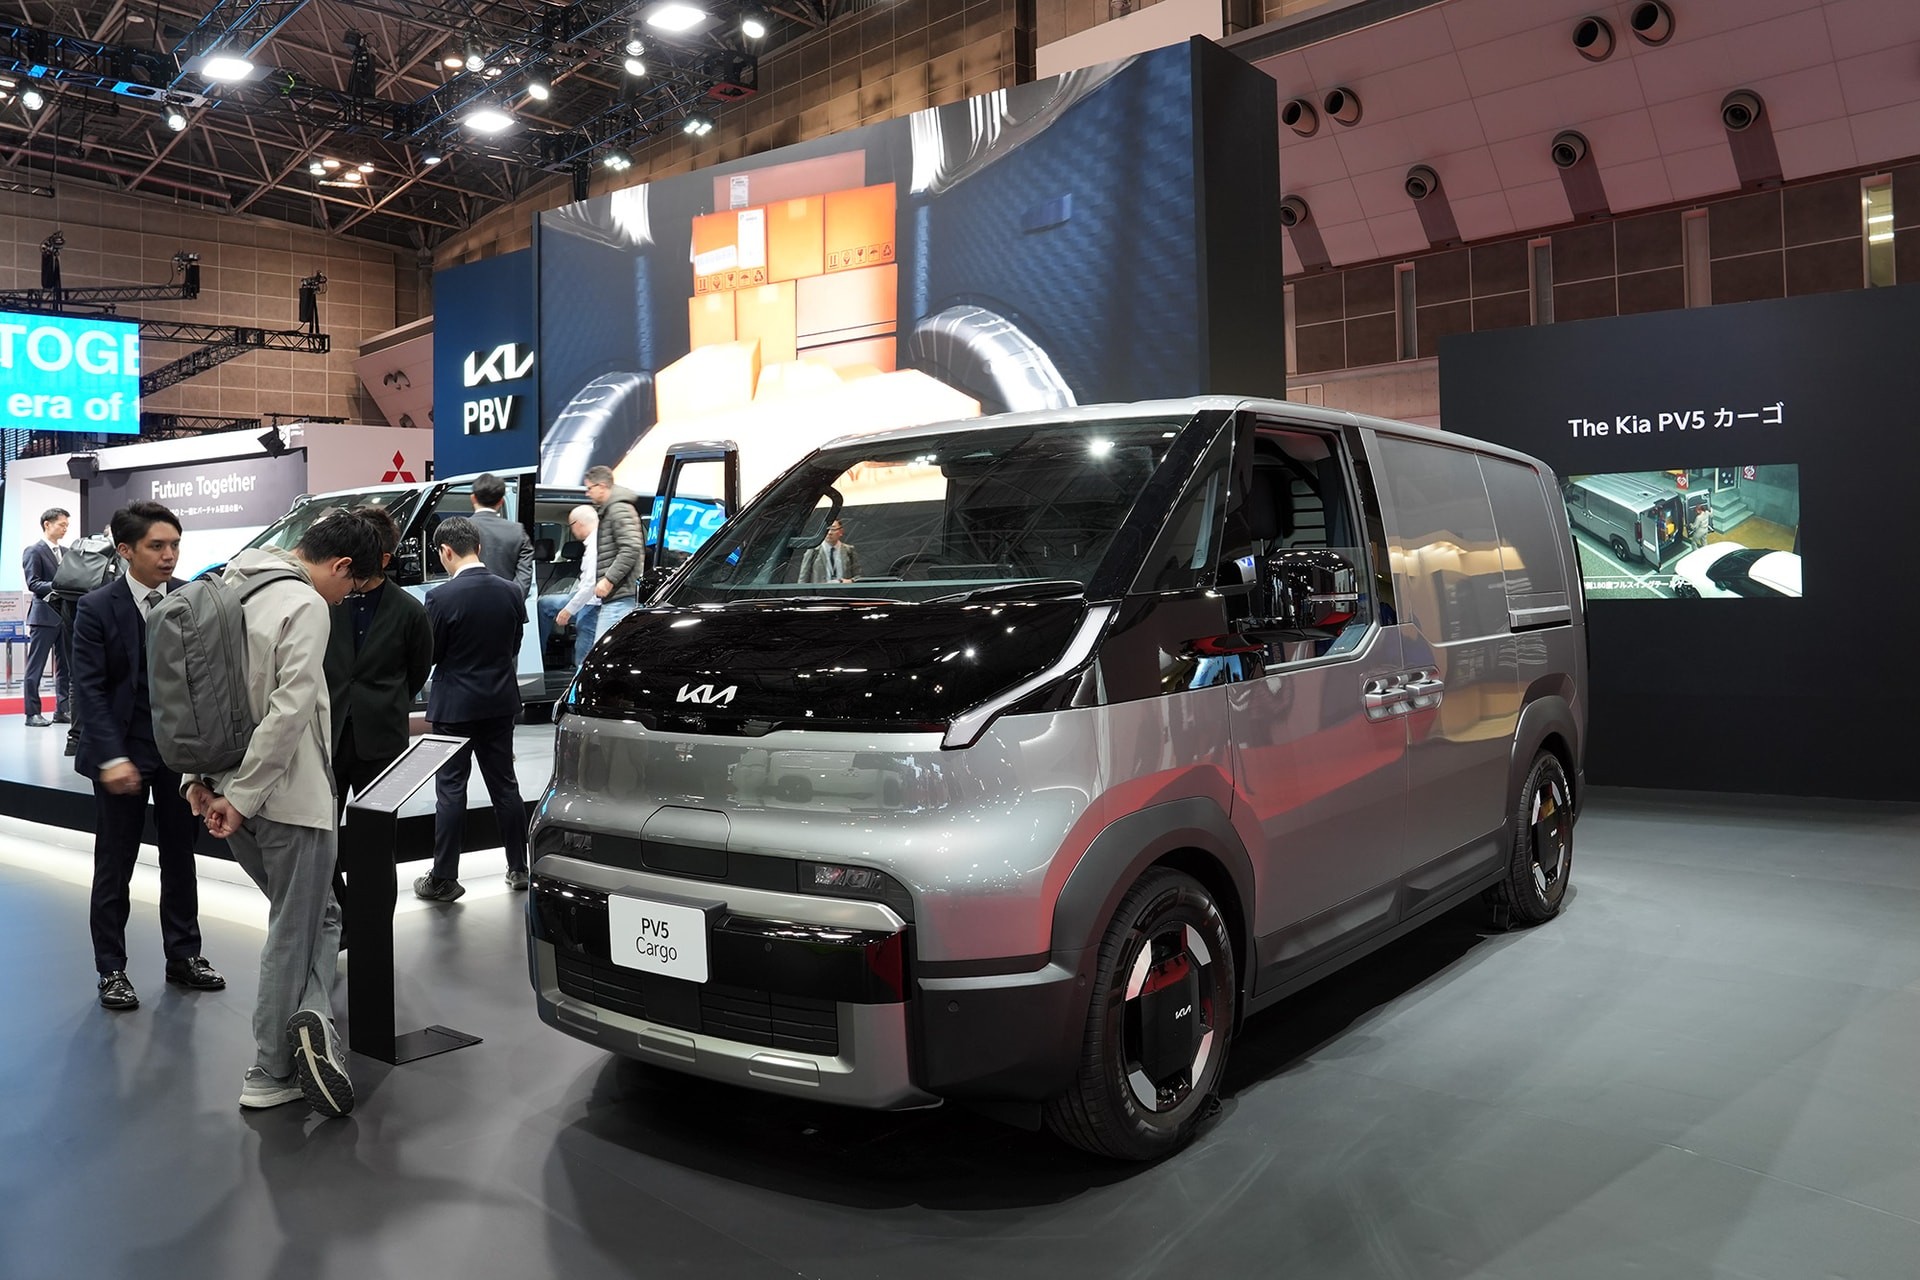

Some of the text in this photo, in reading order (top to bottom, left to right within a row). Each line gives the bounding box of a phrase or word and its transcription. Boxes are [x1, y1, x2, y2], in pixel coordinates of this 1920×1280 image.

[8, 392, 73, 419] era
[84, 391, 124, 421] of
[464, 395, 513, 435] PBV
[1568, 401, 1785, 437] The Kia PV5 カーゴ
[152, 473, 256, 500] Future Together
[676, 683, 738, 705] KIA
[641, 917, 669, 939] PV5
[636, 936, 678, 963] Cargo
